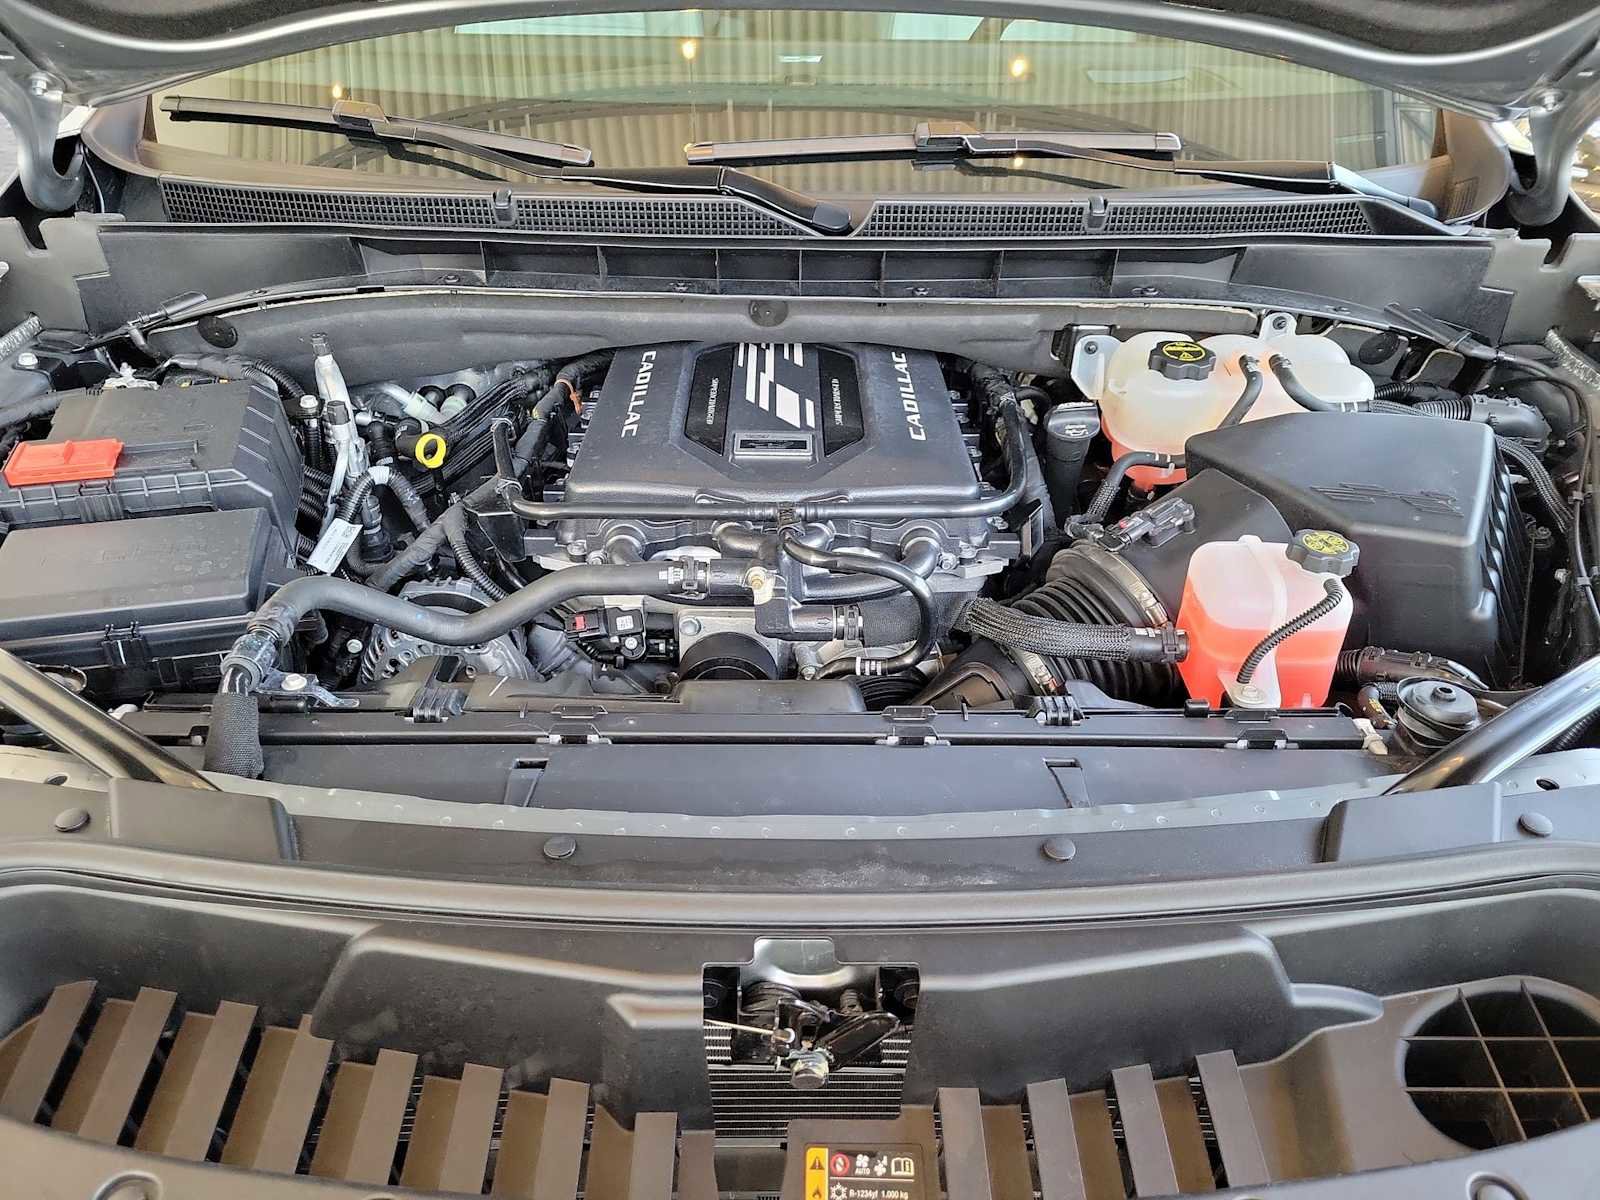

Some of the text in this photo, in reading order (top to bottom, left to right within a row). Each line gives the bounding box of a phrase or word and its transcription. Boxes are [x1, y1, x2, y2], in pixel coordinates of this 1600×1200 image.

[621, 351, 656, 438] CADILLAC
[891, 352, 926, 440] CADILLAC
[849, 1189, 909, 1200] R-1234yf 1.000 kg
[855, 1167, 870, 1175] AUTO
